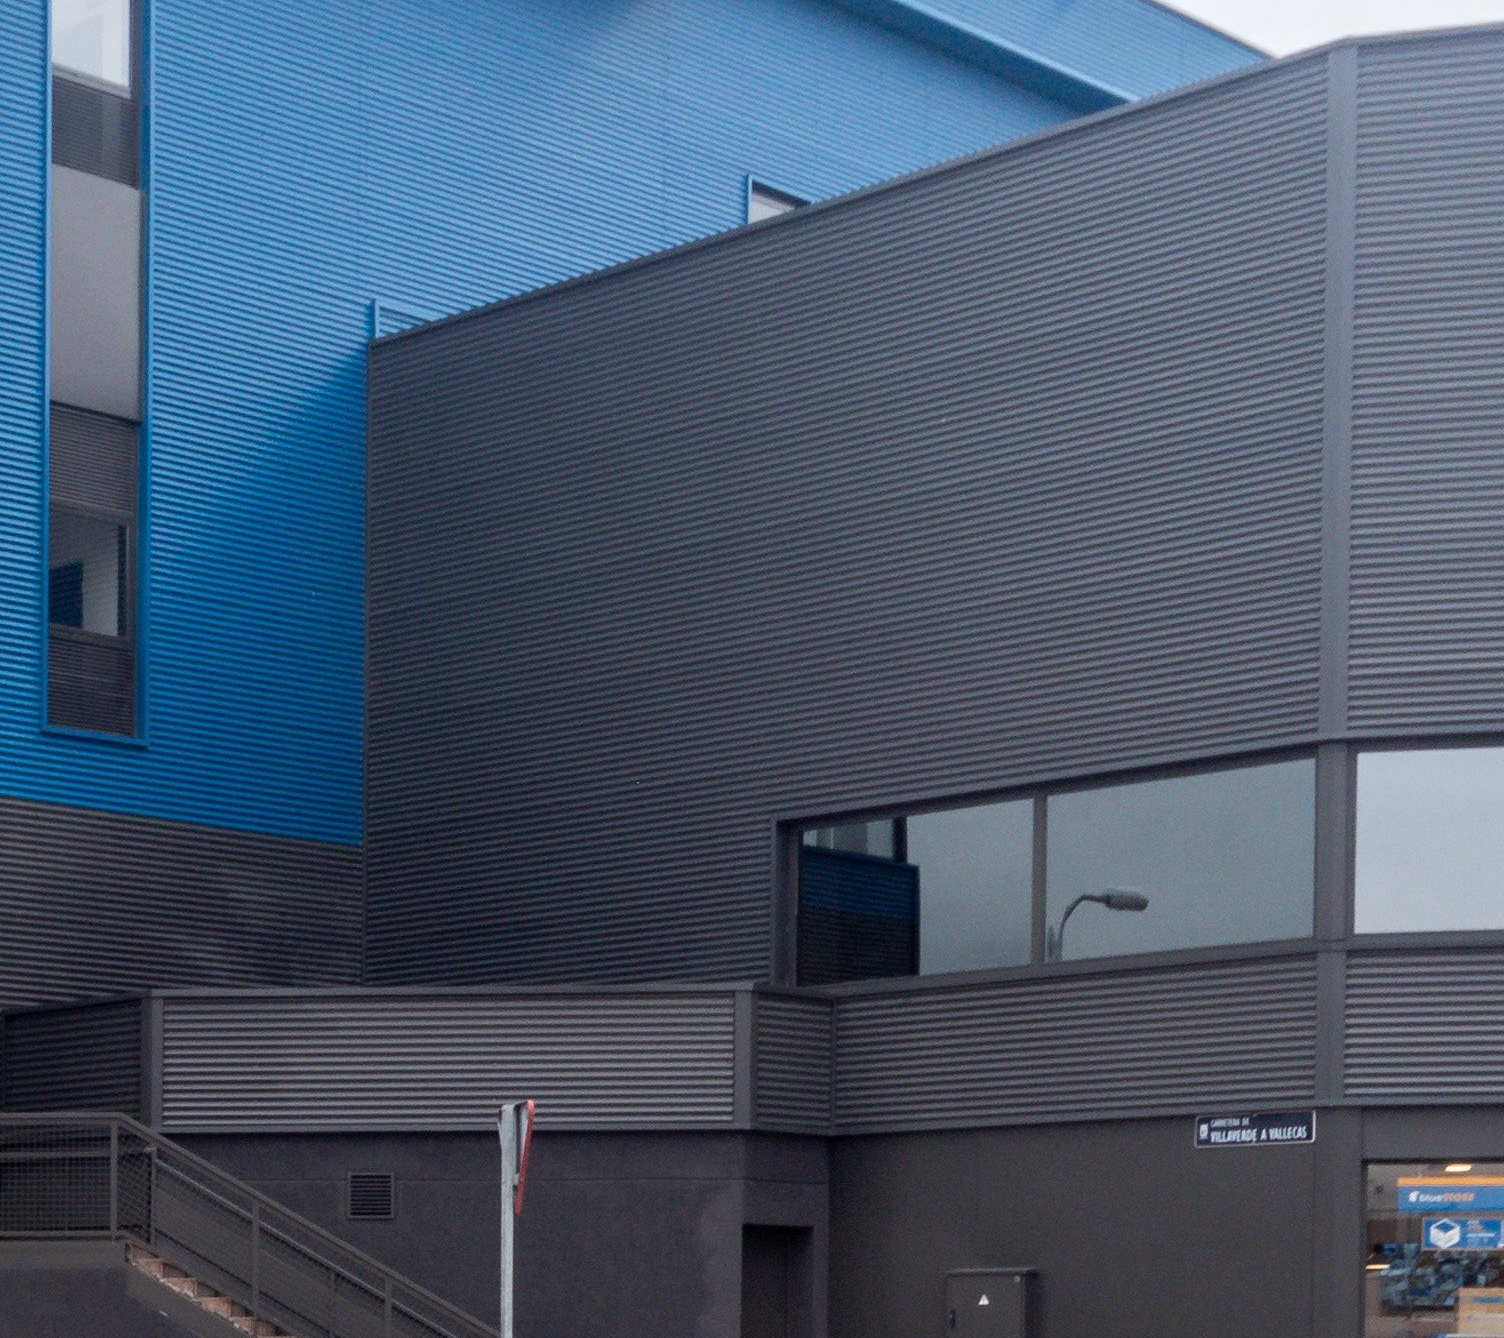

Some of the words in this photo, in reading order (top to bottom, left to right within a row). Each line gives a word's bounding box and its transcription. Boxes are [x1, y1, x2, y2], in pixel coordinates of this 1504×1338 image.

[1210, 1128, 1258, 1143] VILLAVERDE
[1259, 1127, 1268, 1141] A
[1268, 1125, 1308, 1141] VALLECAS
